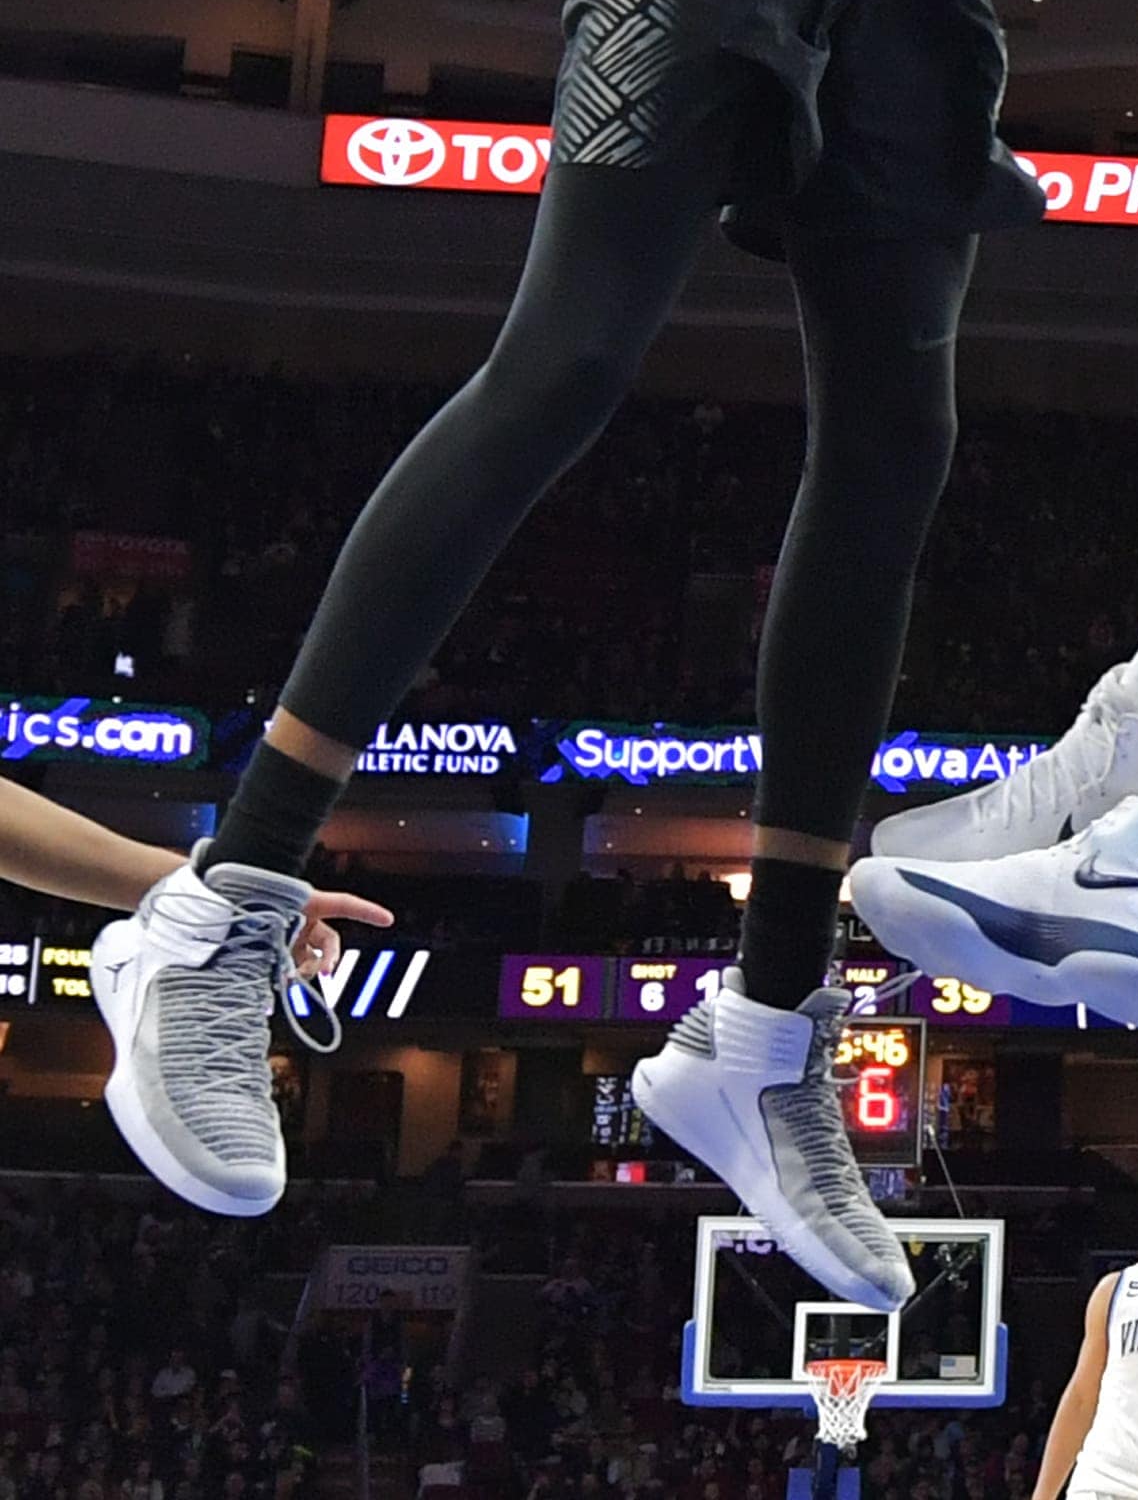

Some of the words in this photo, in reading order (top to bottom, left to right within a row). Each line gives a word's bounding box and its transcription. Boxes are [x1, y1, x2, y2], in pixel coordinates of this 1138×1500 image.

[0, 702, 193, 755] ics.com
[367, 723, 517, 753] LANOVA
[433, 754, 500, 774] FUND
[521, 966, 581, 1007] 51
[631, 964, 677, 980] SHOT
[846, 968, 888, 983] HALF
[639, 981, 666, 1012] 6
[858, 1067, 894, 1126] 6
